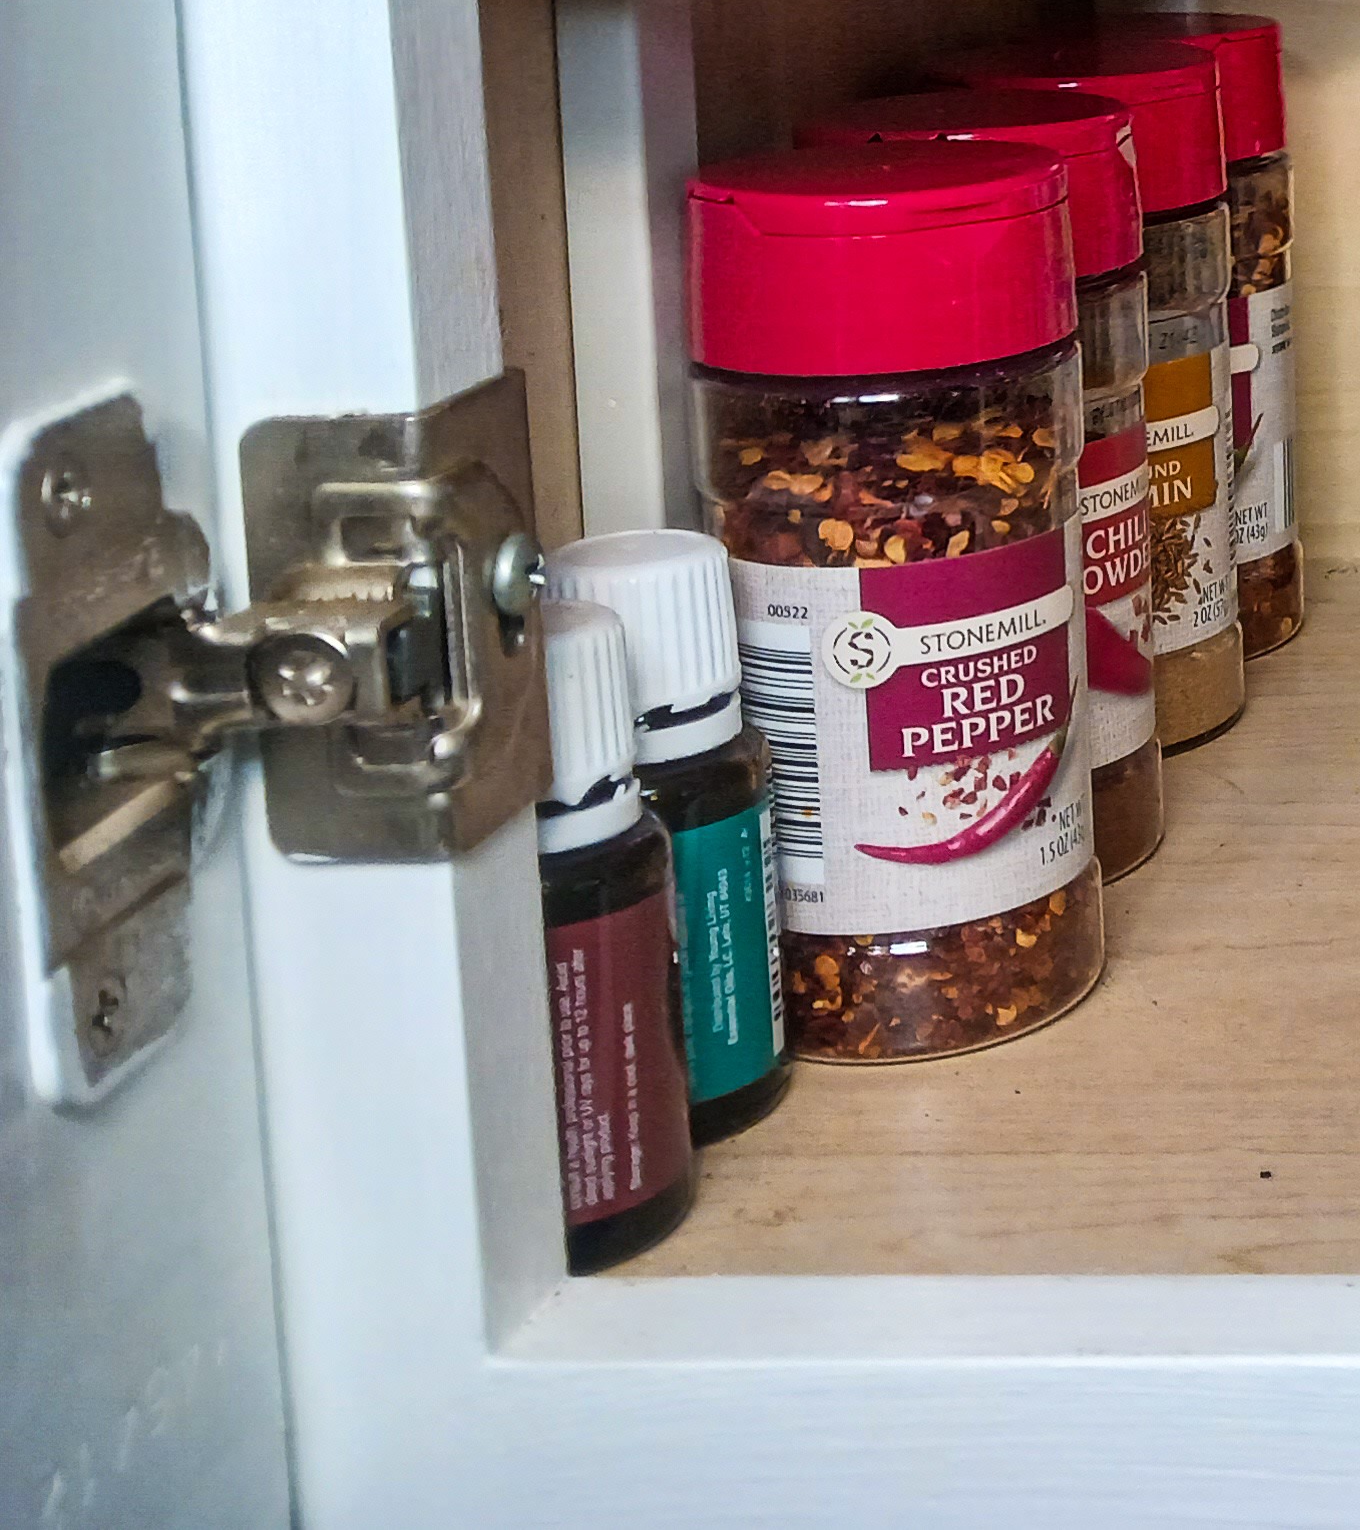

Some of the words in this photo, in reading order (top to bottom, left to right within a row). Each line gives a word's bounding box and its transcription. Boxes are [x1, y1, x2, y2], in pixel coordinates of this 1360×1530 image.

[1235, 506, 1253, 526] NET
[1254, 502, 1268, 520] WT
[1202, 581, 1218, 604] NET
[1193, 611, 1199, 628] 2
[1200, 604, 1212, 625] OZ
[921, 644, 1038, 688] CRUSHED
[940, 673, 1026, 720] RED
[902, 693, 1056, 758] PEPPER
[1041, 840, 1055, 866] 1.5
[1056, 832, 1069, 857] OZ
